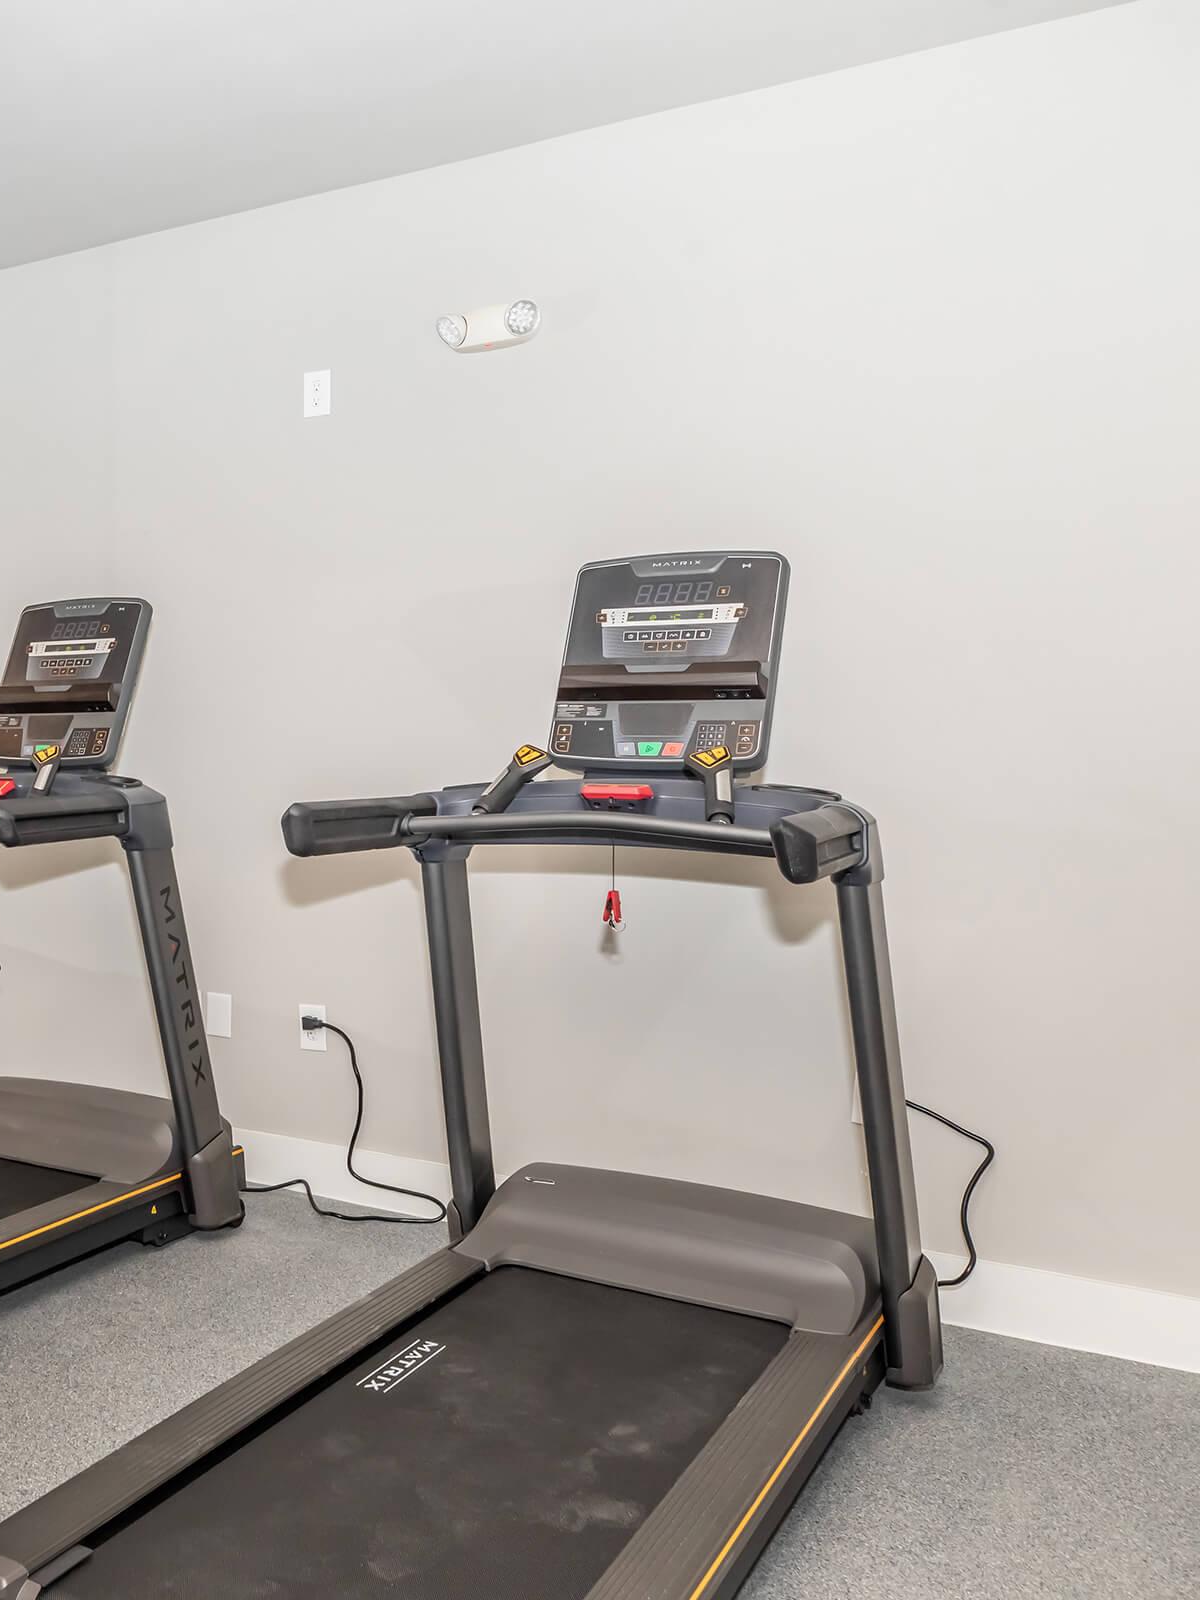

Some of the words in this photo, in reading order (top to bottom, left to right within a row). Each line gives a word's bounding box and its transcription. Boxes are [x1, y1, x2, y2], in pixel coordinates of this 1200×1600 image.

[652, 559, 702, 568] MATRIX
[160, 886, 206, 1088] MATRIX
[363, 1340, 439, 1391] MATRIX
